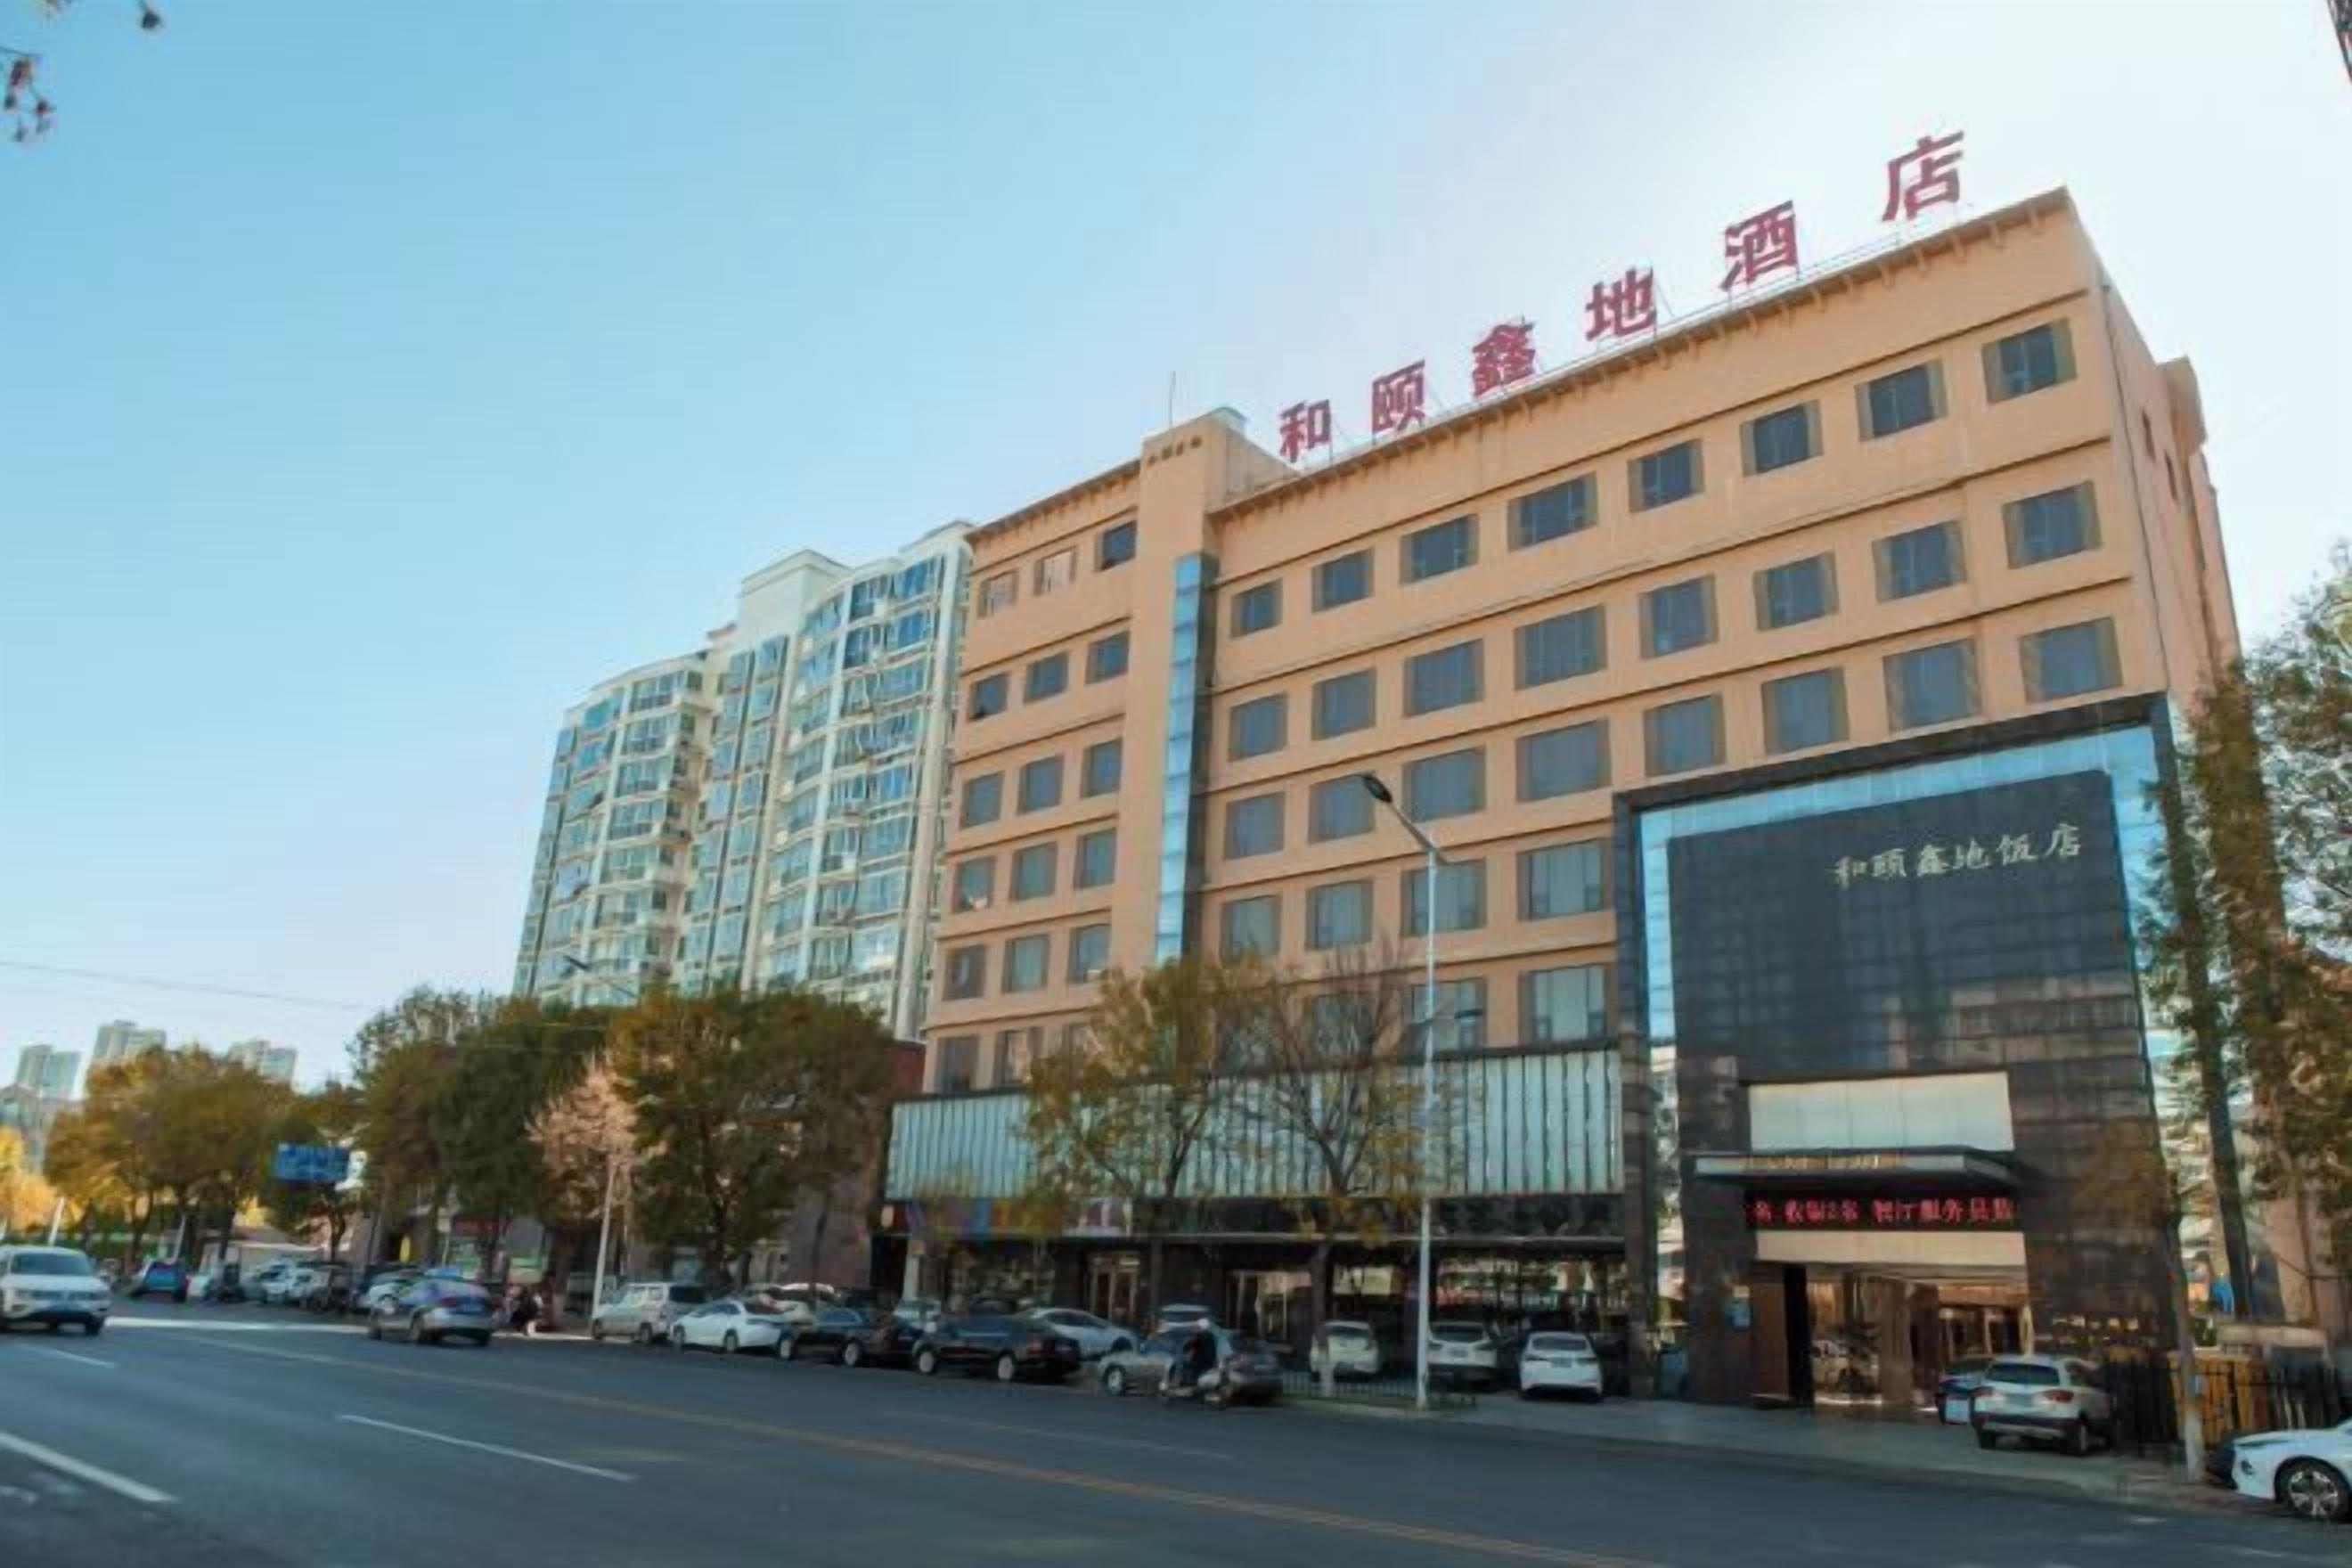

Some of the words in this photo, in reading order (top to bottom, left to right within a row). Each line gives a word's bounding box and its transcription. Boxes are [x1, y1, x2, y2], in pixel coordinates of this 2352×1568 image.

[1279, 130, 1964, 461] 和颐鑫地酒店
